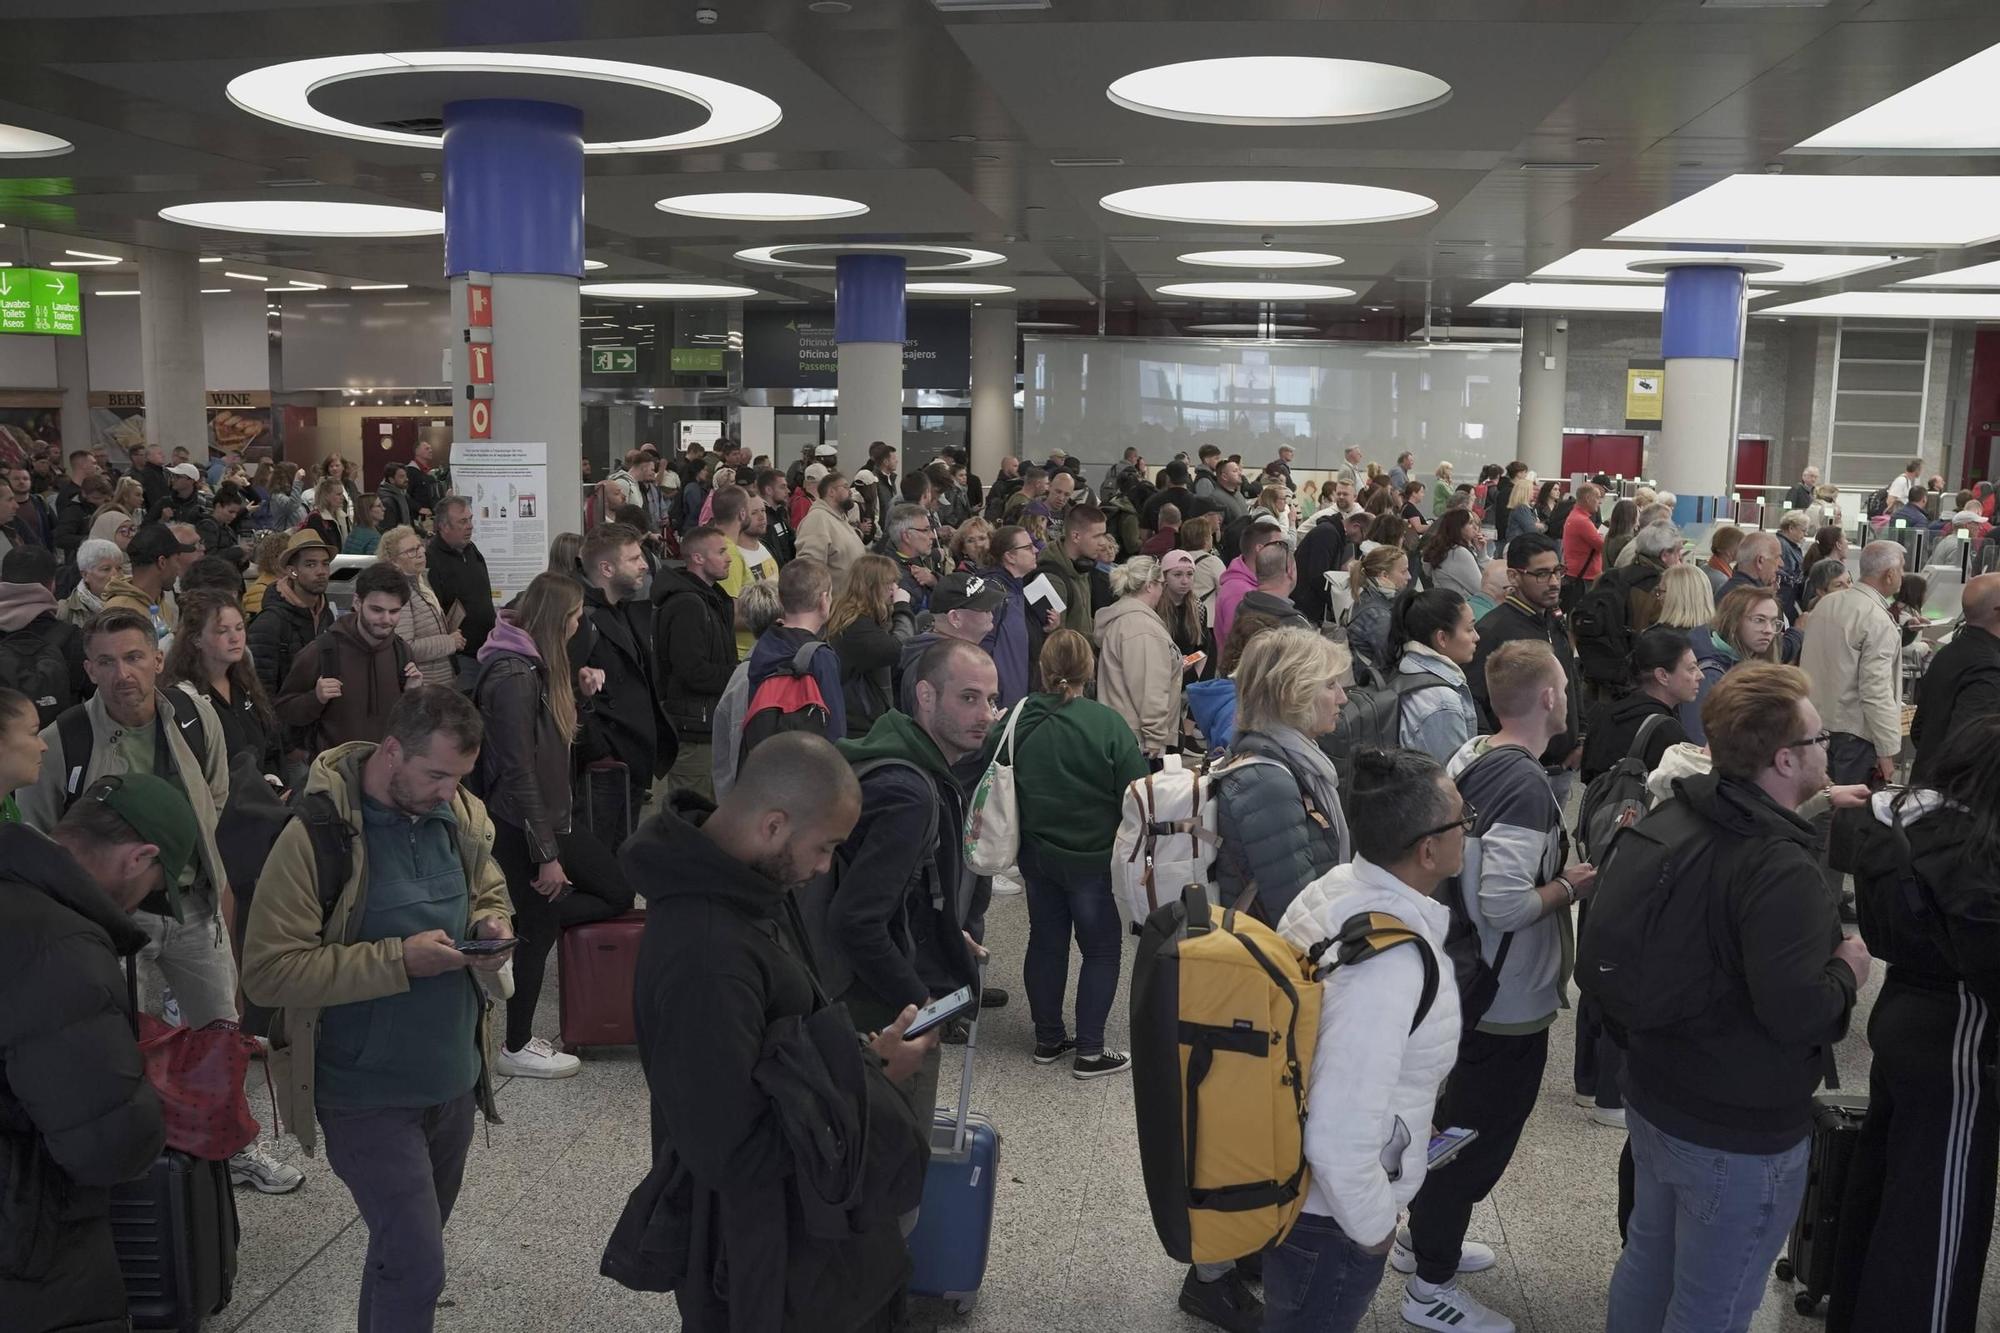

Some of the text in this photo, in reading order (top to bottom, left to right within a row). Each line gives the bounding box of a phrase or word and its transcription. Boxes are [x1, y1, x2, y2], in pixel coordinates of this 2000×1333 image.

[1, 300, 31, 309] Lavabos
[53, 302, 80, 312] Lavabos
[2, 309, 26, 318] Toilets
[54, 312, 74, 321] Toilets
[3, 319, 24, 328] Aseos
[54, 321, 73, 330] Aseos
[799, 338, 828, 347] Oficina
[799, 349, 830, 359] Oficina
[903, 350, 937, 360] sajeros
[108, 393, 144, 406] BEER
[211, 393, 251, 406] WINE
